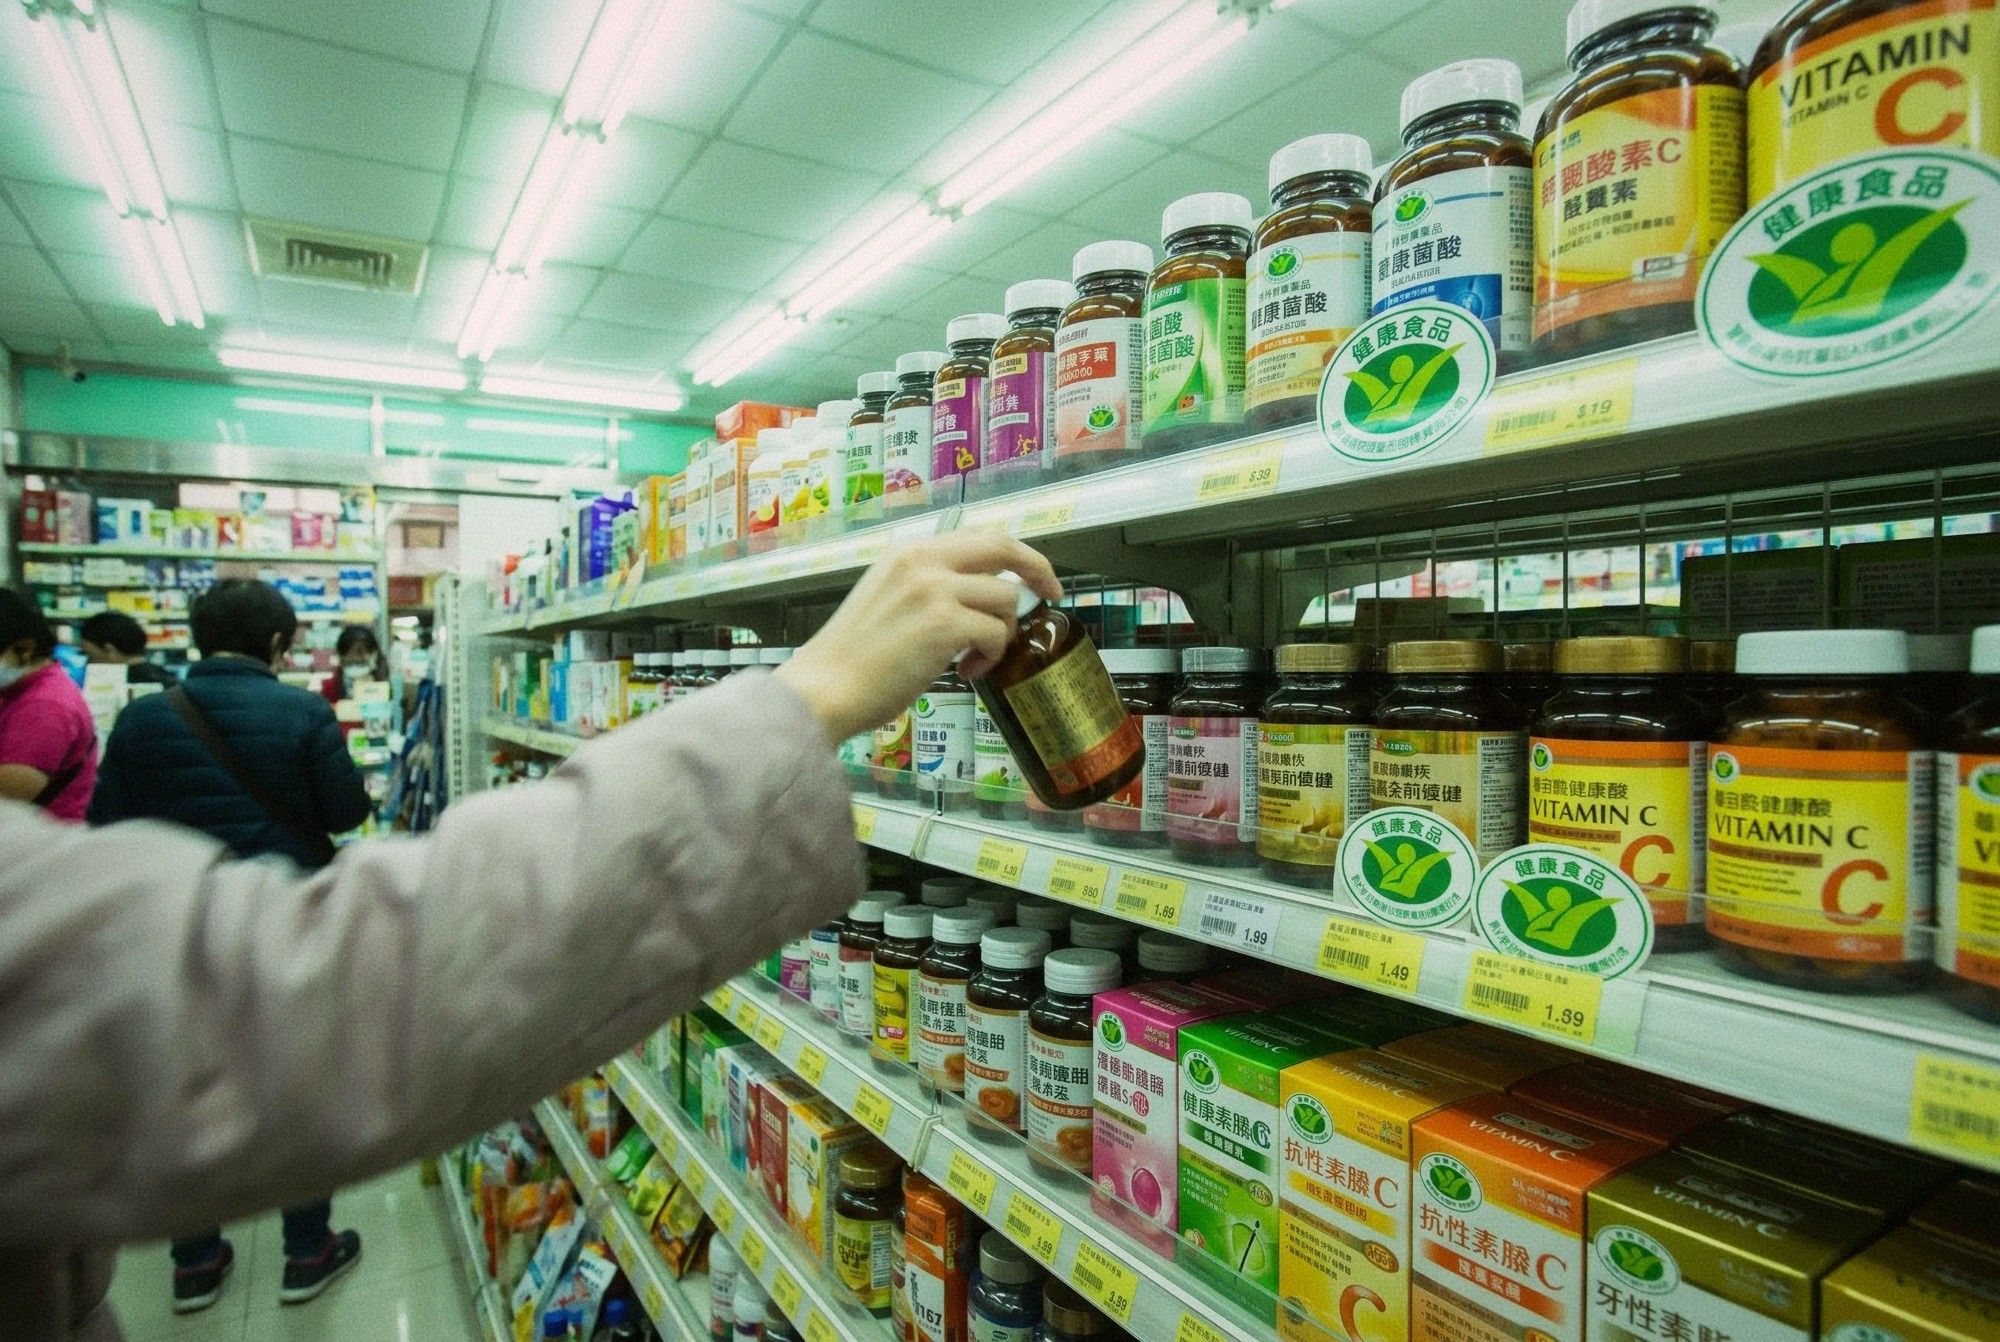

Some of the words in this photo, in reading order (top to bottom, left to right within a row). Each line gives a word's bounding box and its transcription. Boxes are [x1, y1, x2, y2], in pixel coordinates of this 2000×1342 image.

[1779, 22, 1971, 107] VITAMIN
[1854, 84, 1870, 100] C
[1874, 65, 1969, 146] C
[1763, 164, 1949, 242] 健康食品
[1351, 315, 1453, 364] 健康食品
[1371, 816, 1443, 845] 健康食品
[1532, 797, 1630, 826] VITAMIN
[1638, 805, 1658, 827] C
[1714, 812, 1834, 848] VITAMIN
[1846, 825, 1869, 850] C
[1515, 856, 1607, 891] 健康食品
[1619, 834, 1676, 889] C
[1820, 858, 1890, 926] C
[1243, 927, 1268, 945] 1.99
[1379, 961, 1410, 982] 1.49
[1223, 1026, 1270, 1051] VITAMIN
[1270, 1045, 1289, 1055] C
[1467, 1119, 1550, 1153] VITAMIN
[1549, 1149, 1577, 1162] C
[1651, 1184, 1751, 1228] VITAMIN
[1755, 1222, 1788, 1240] C
